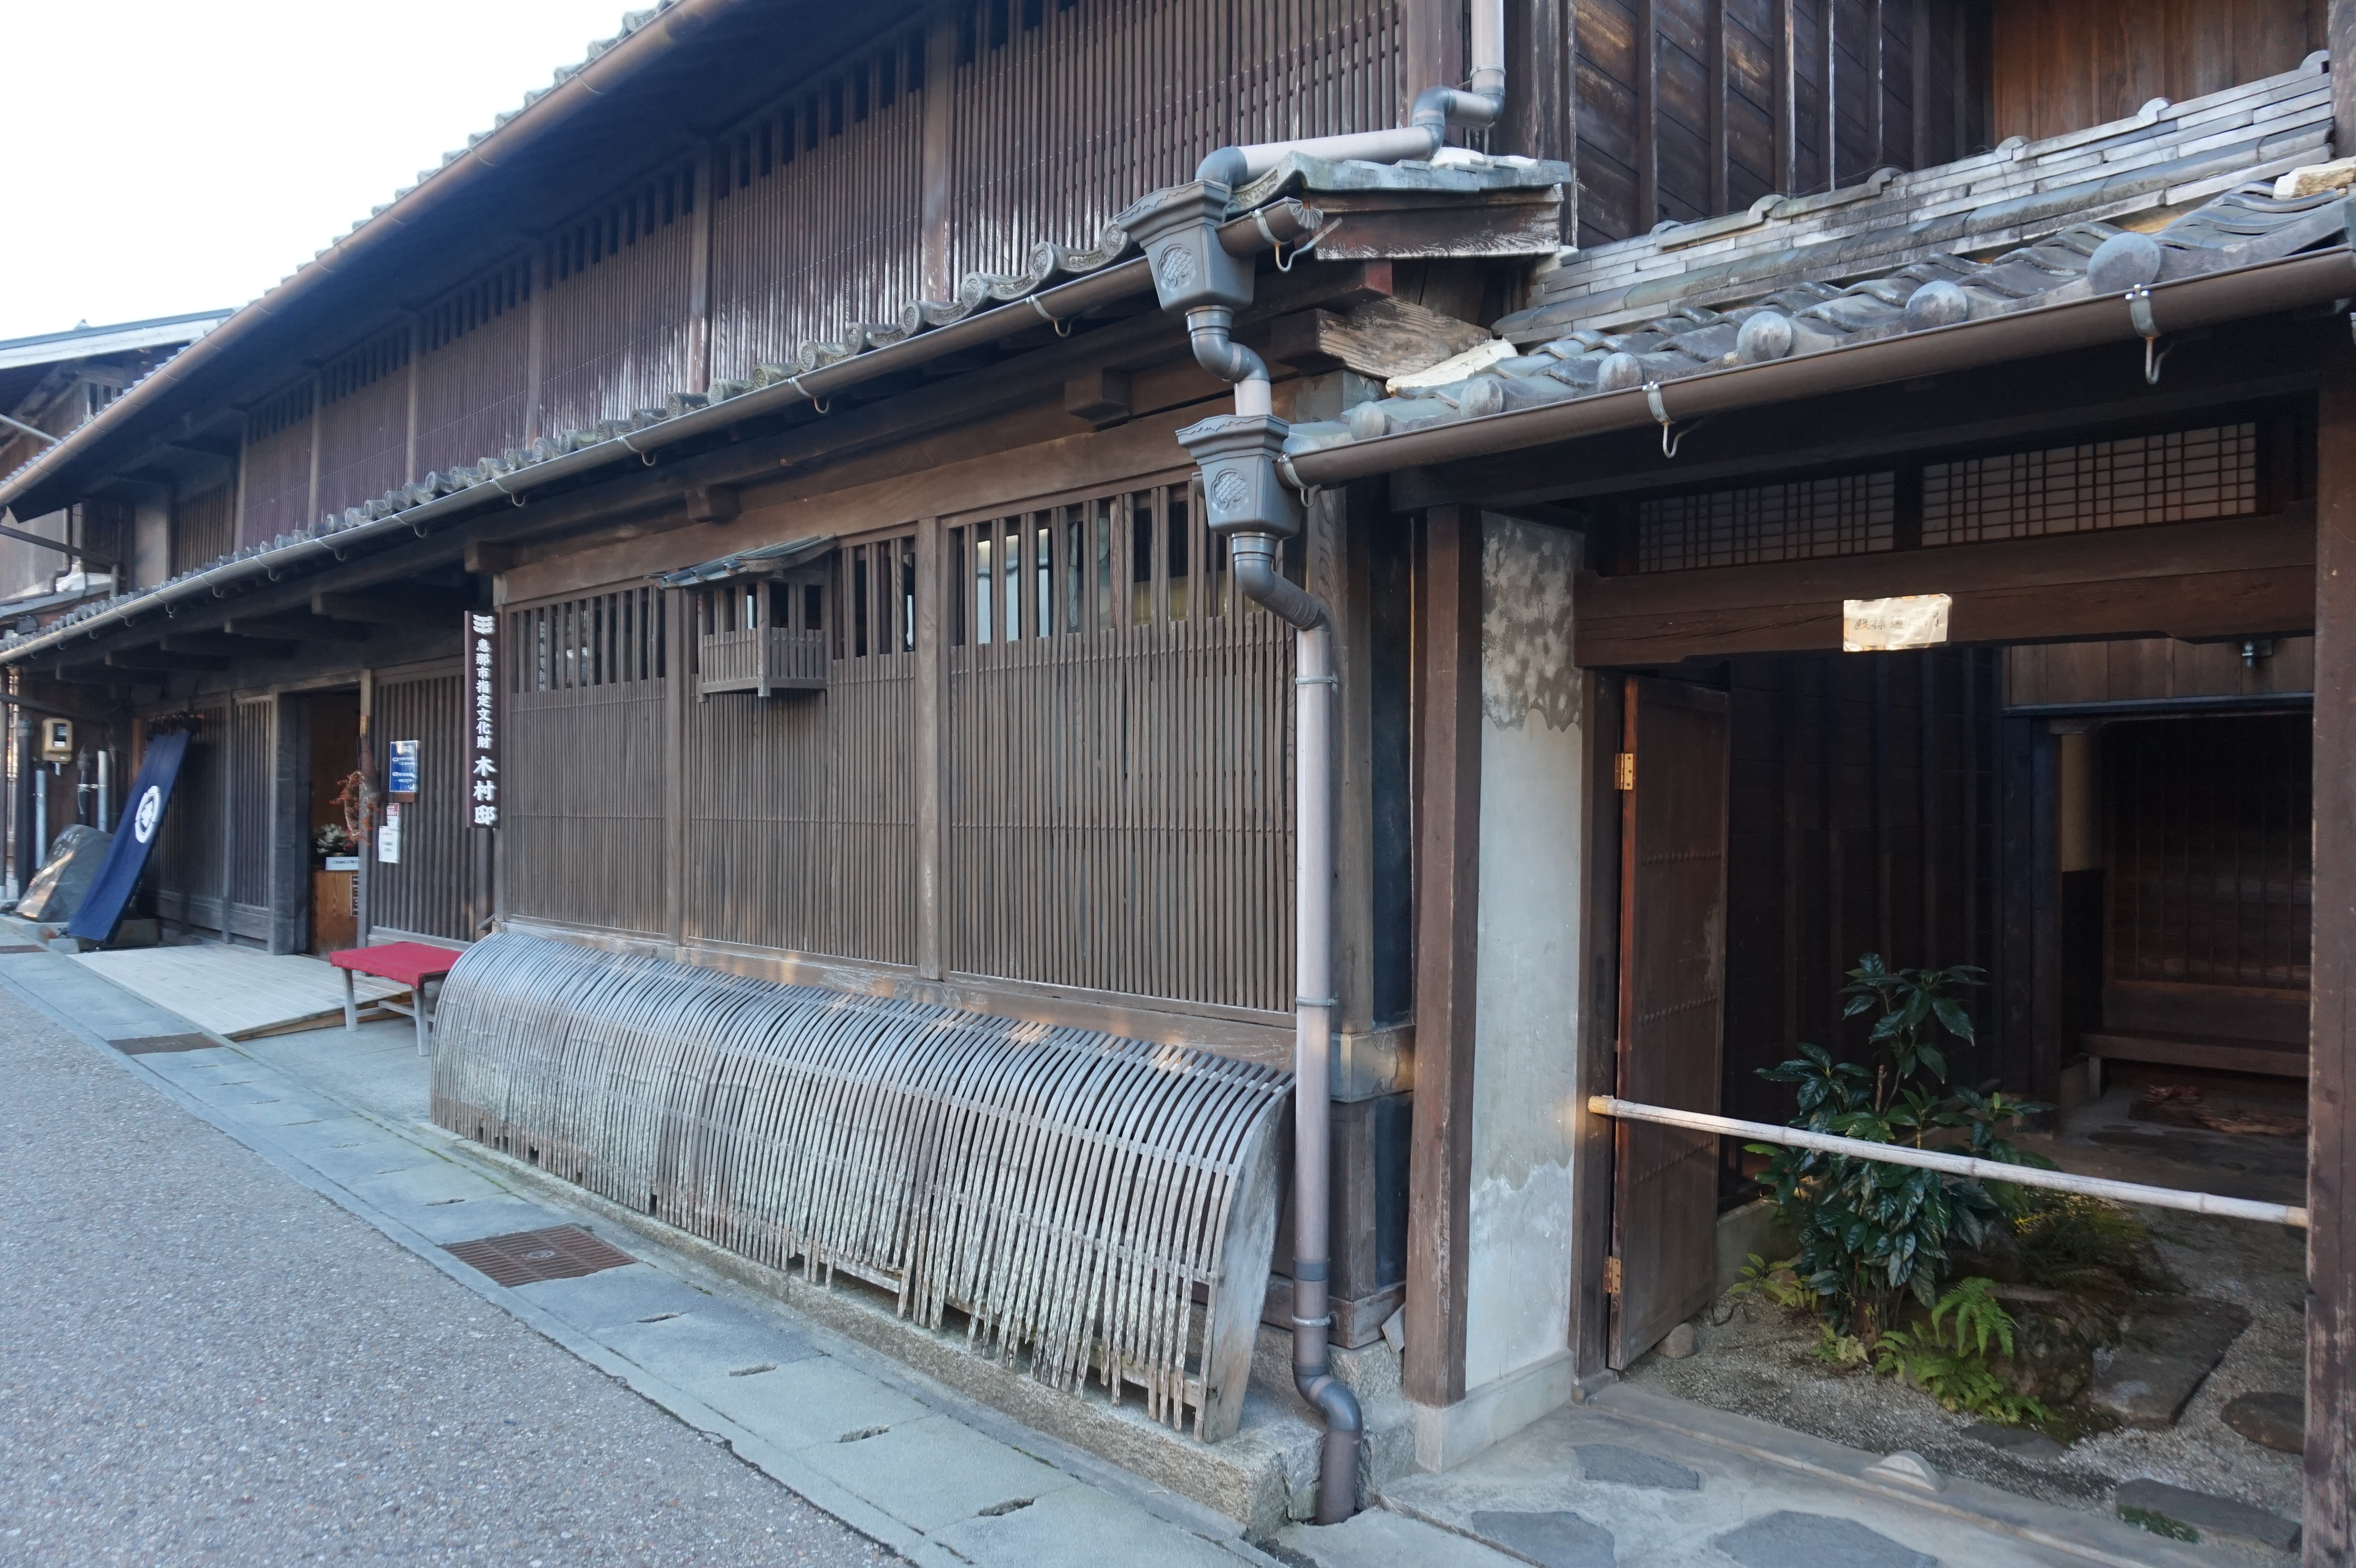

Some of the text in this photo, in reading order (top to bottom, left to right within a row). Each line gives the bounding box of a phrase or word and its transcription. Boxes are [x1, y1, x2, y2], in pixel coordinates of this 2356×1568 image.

[473, 638, 496, 825] 恵那市指定文化財 木村邸
